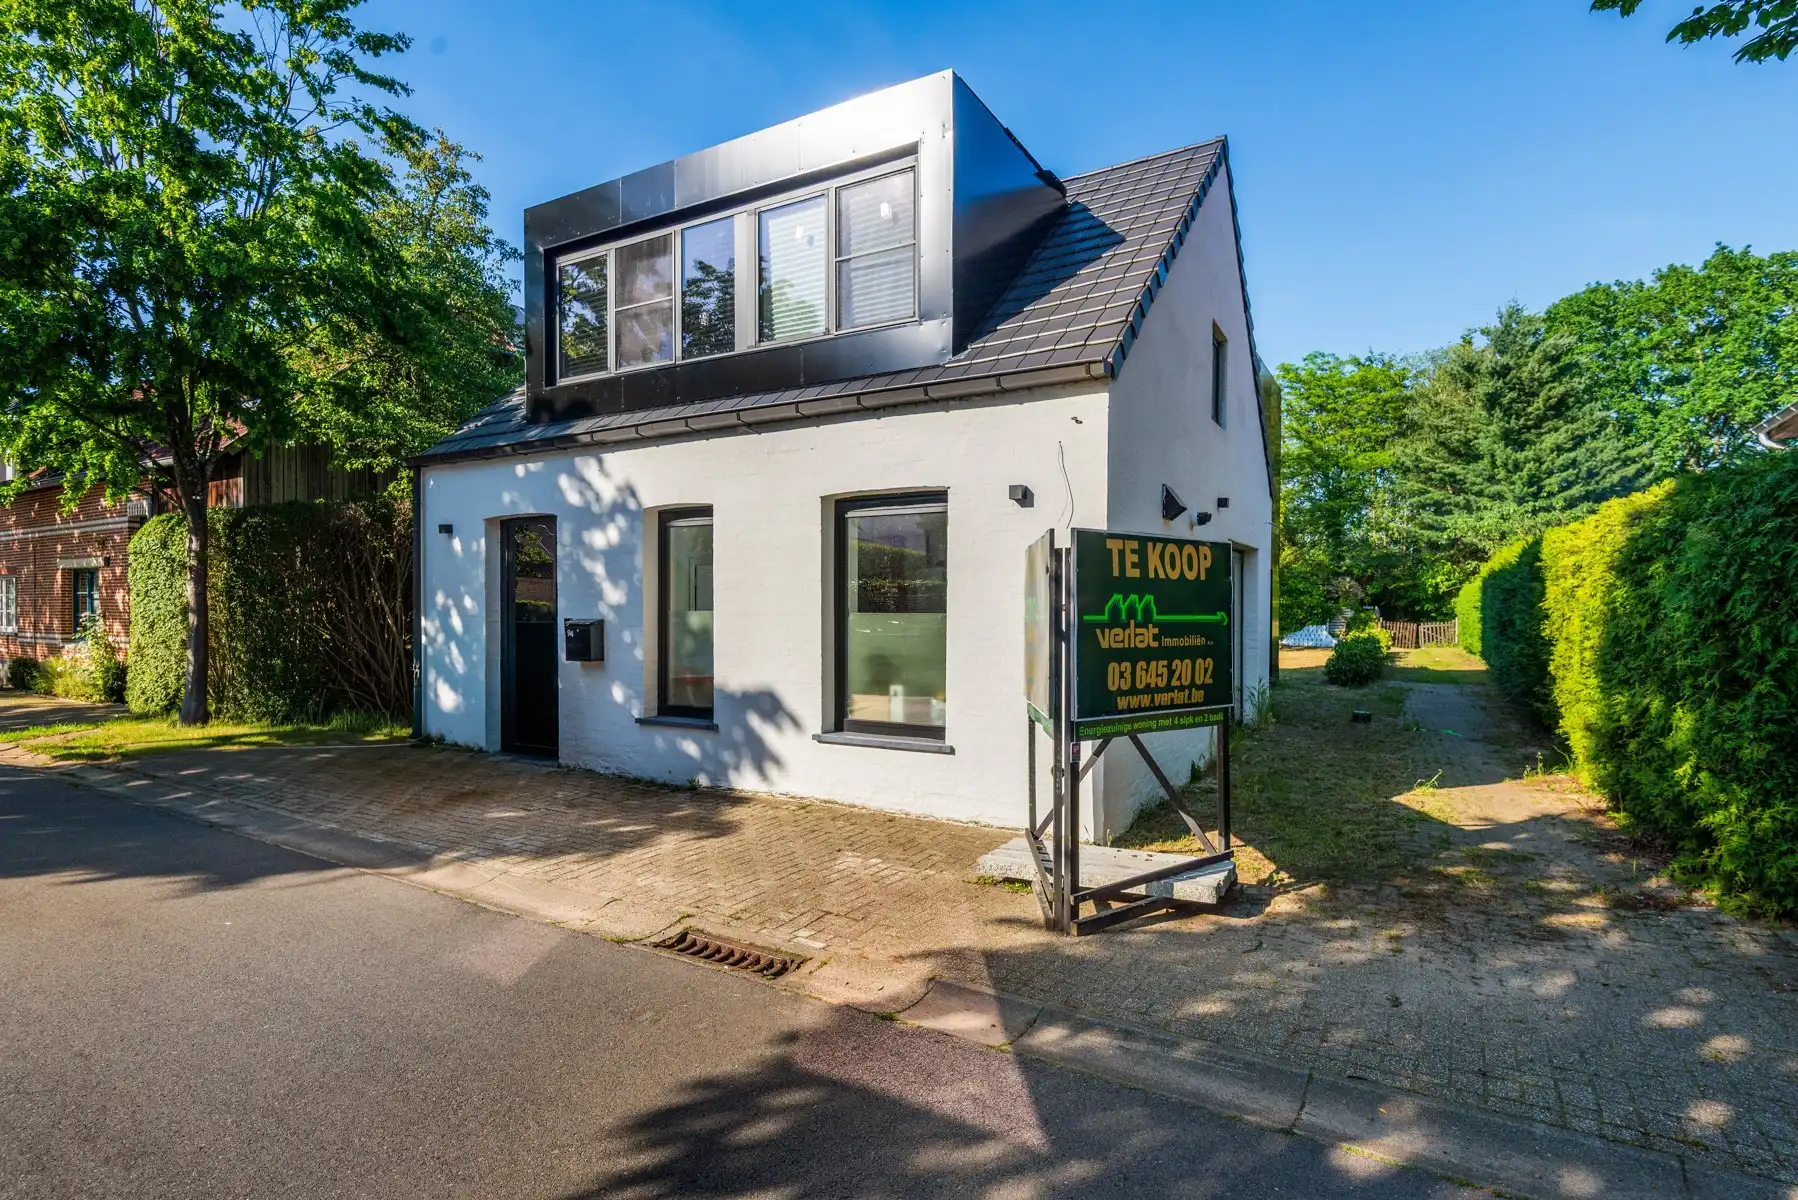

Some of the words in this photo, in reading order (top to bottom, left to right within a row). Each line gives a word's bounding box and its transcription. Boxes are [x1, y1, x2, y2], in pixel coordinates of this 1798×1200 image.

[1106, 538, 1141, 578] TE
[1147, 541, 1212, 581] KOOP
[1095, 619, 1160, 649] verlat
[1161, 634, 1206, 647] Immobiliën
[1107, 661, 1132, 692] 03
[1135, 659, 1168, 689] 645
[1171, 658, 1192, 687] 20
[1194, 657, 1214, 685] 02
[1116, 687, 1205, 710] www.verlat.be
[1079, 722, 1132, 737] Energiezuinige
[1133, 719, 1157, 730] woning
[1158, 716, 1172, 727] met
[1173, 716, 1179, 725] 4
[1195, 716, 1203, 724] en
[1204, 713, 1209, 722] 2
